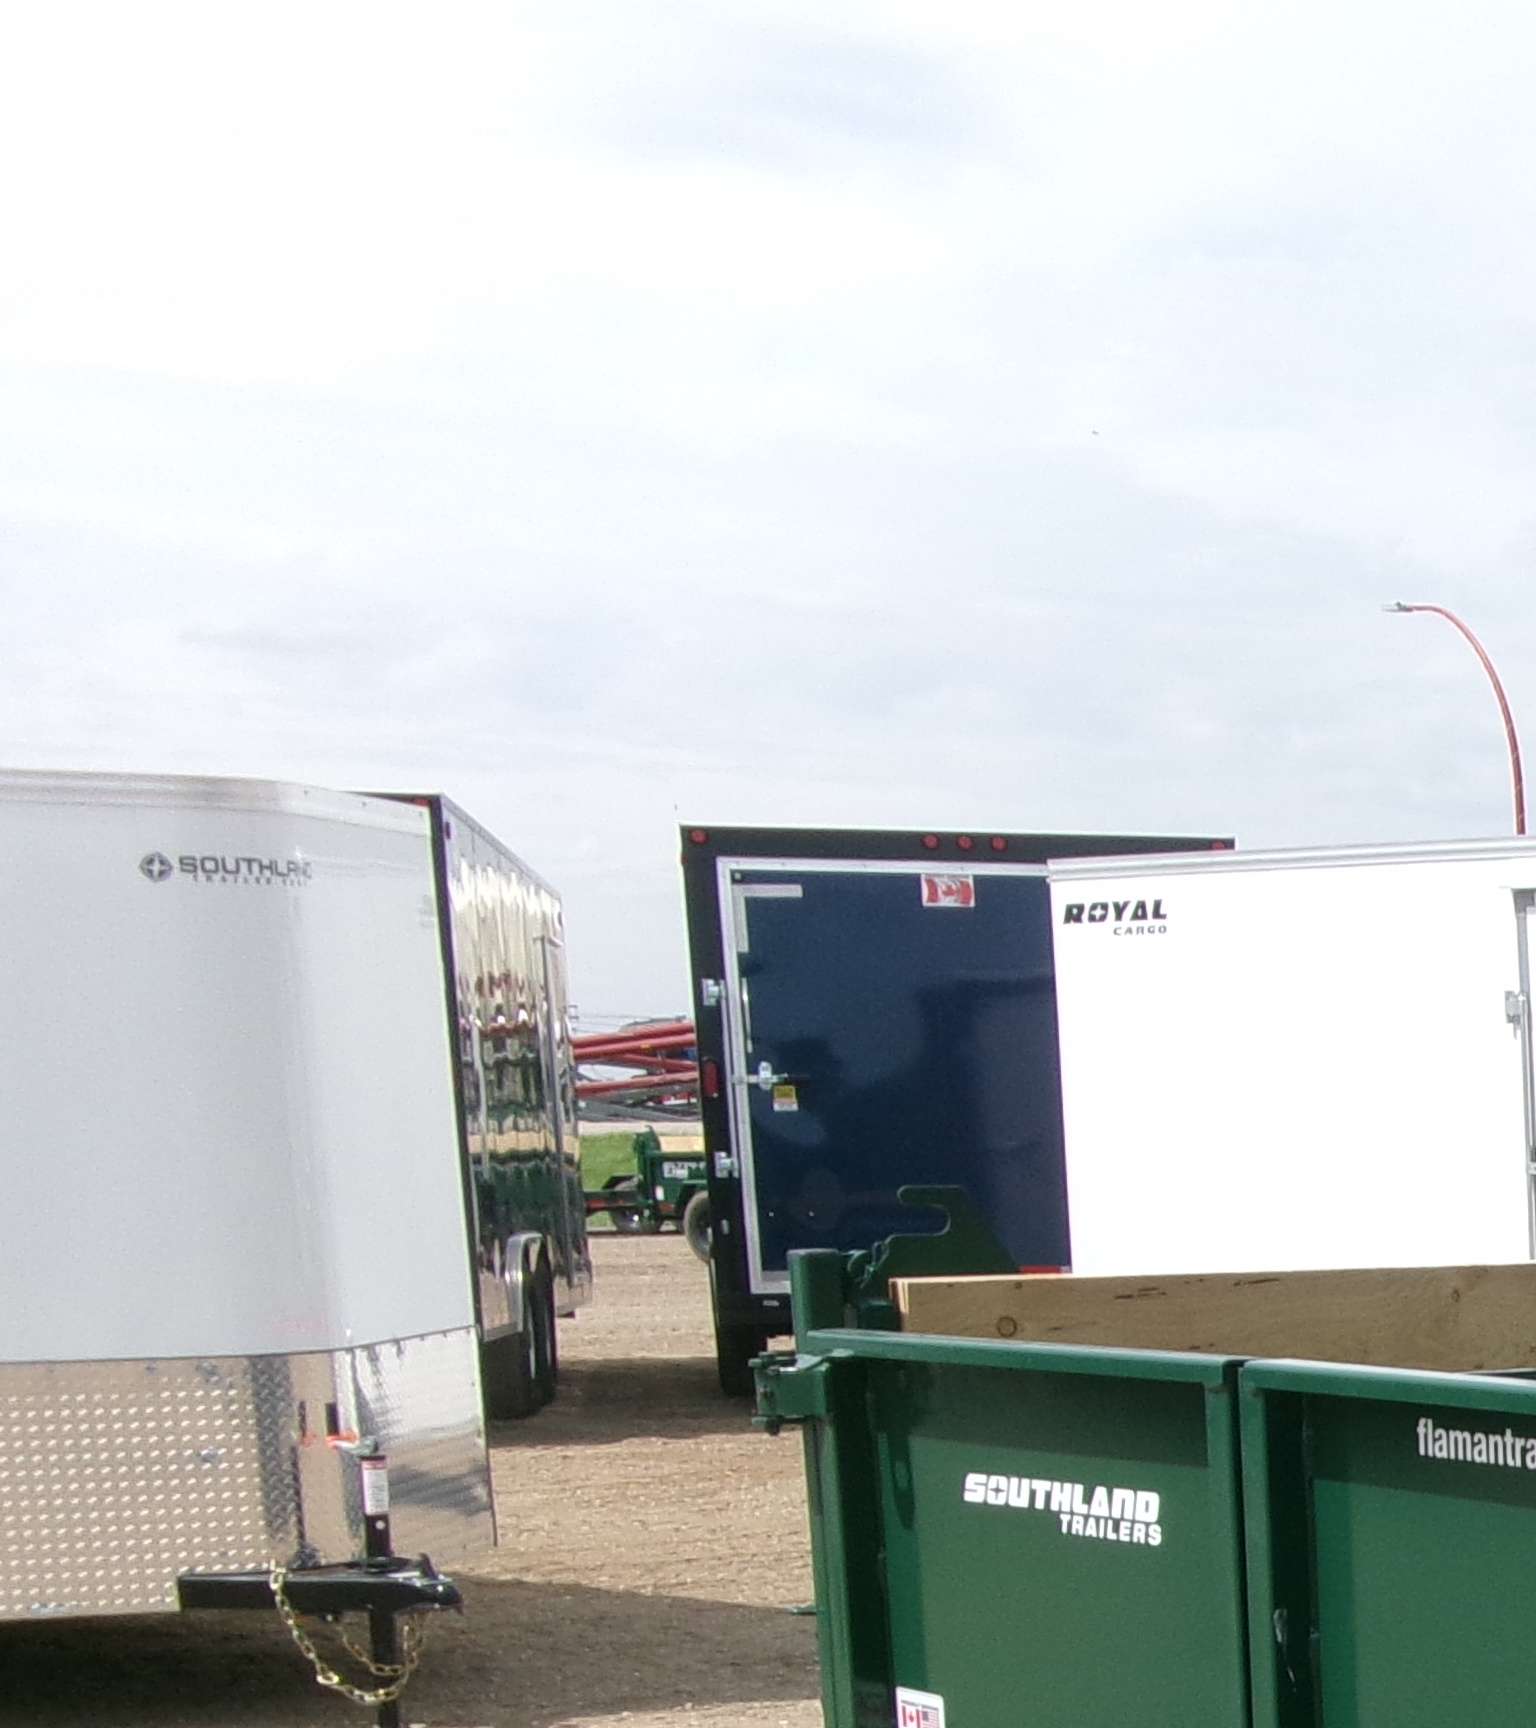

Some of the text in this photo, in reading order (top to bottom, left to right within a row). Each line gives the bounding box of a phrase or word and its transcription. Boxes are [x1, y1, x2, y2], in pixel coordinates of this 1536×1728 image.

[1063, 899, 1168, 925] ROYAL
[1113, 925, 1168, 936] CARGO
[963, 1472, 1160, 1524] SOUTHLAND
[1059, 1513, 1163, 1547] TRAILERS
